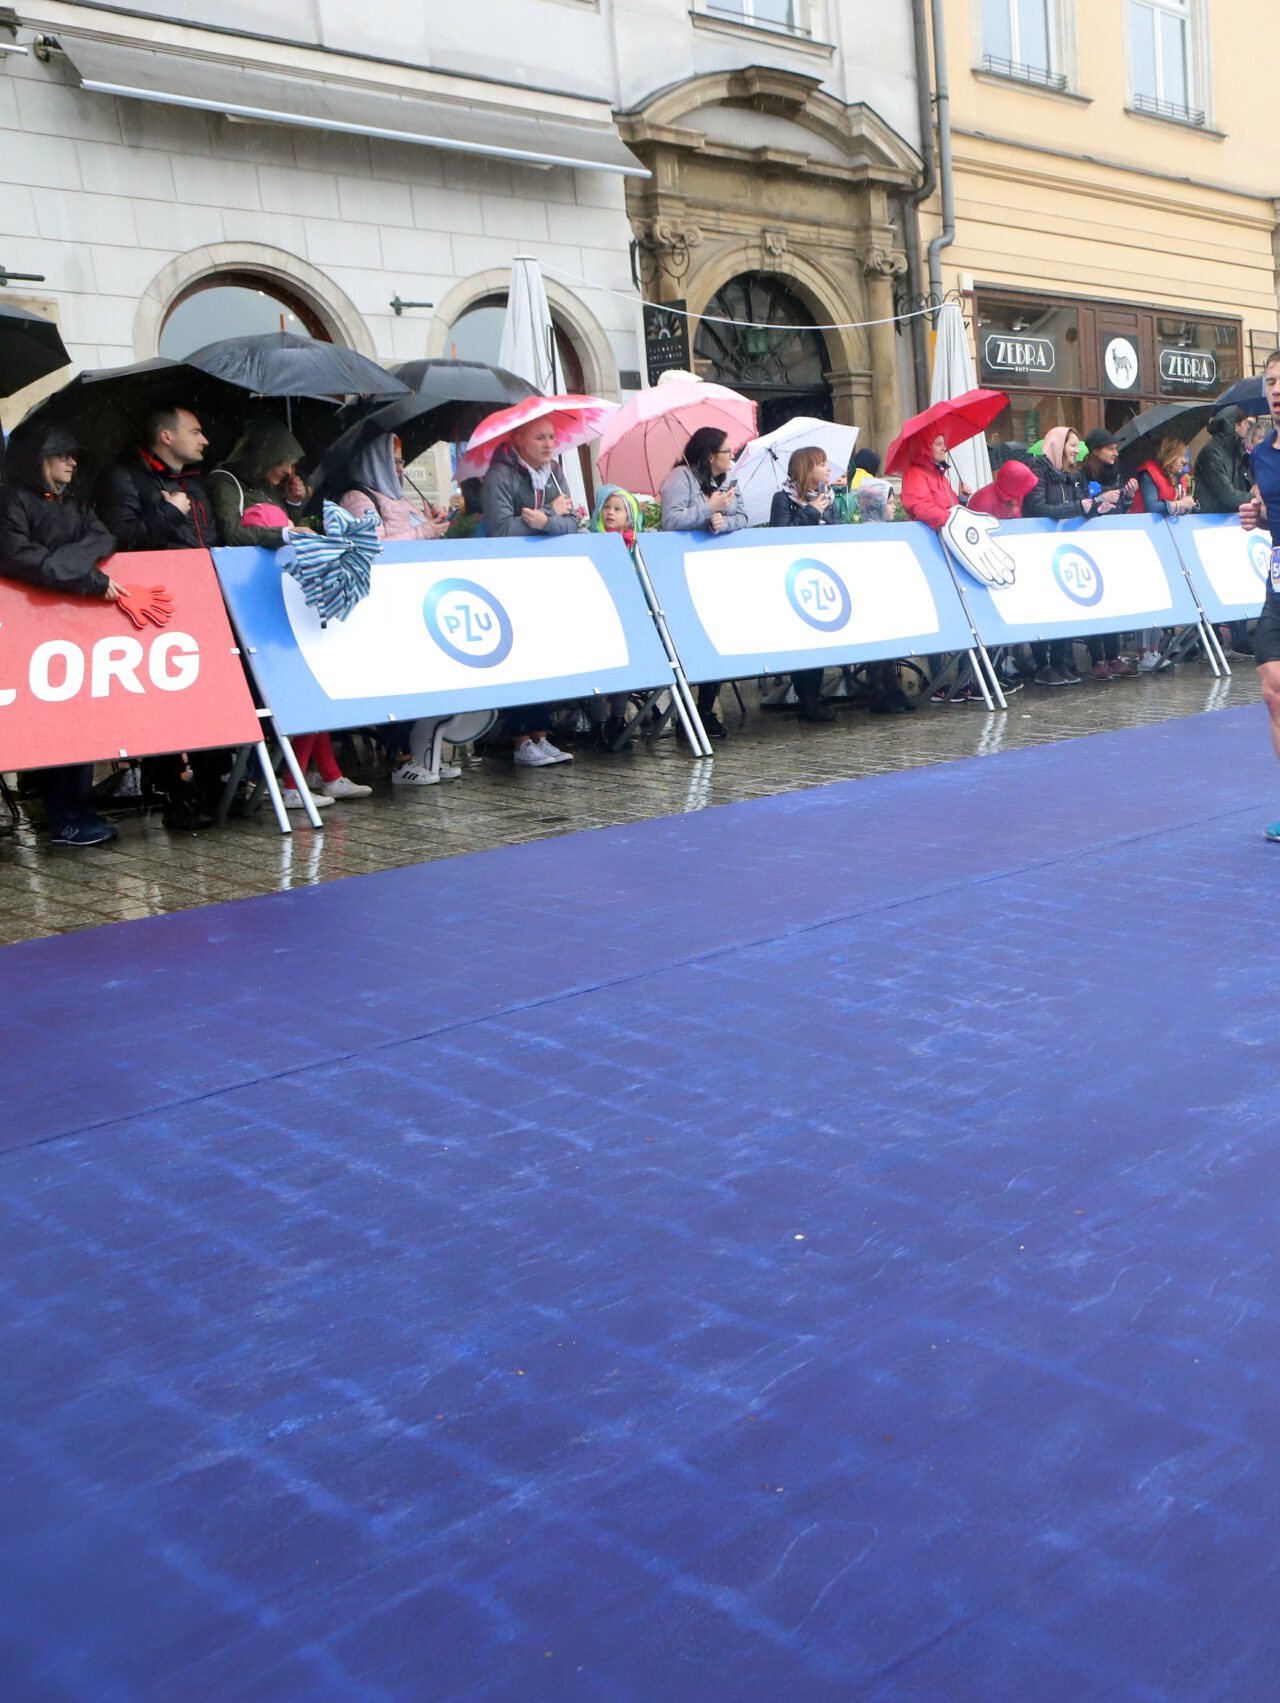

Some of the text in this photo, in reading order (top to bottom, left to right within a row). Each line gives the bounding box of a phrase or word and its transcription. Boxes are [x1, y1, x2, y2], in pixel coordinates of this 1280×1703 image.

[996, 341, 1046, 367] ZEBRA
[1168, 355, 1210, 379] ZEBRA
[1064, 562, 1092, 588] PZU
[800, 580, 836, 610] PZU
[443, 604, 493, 642] PZU
[0, 631, 200, 707] ORG
